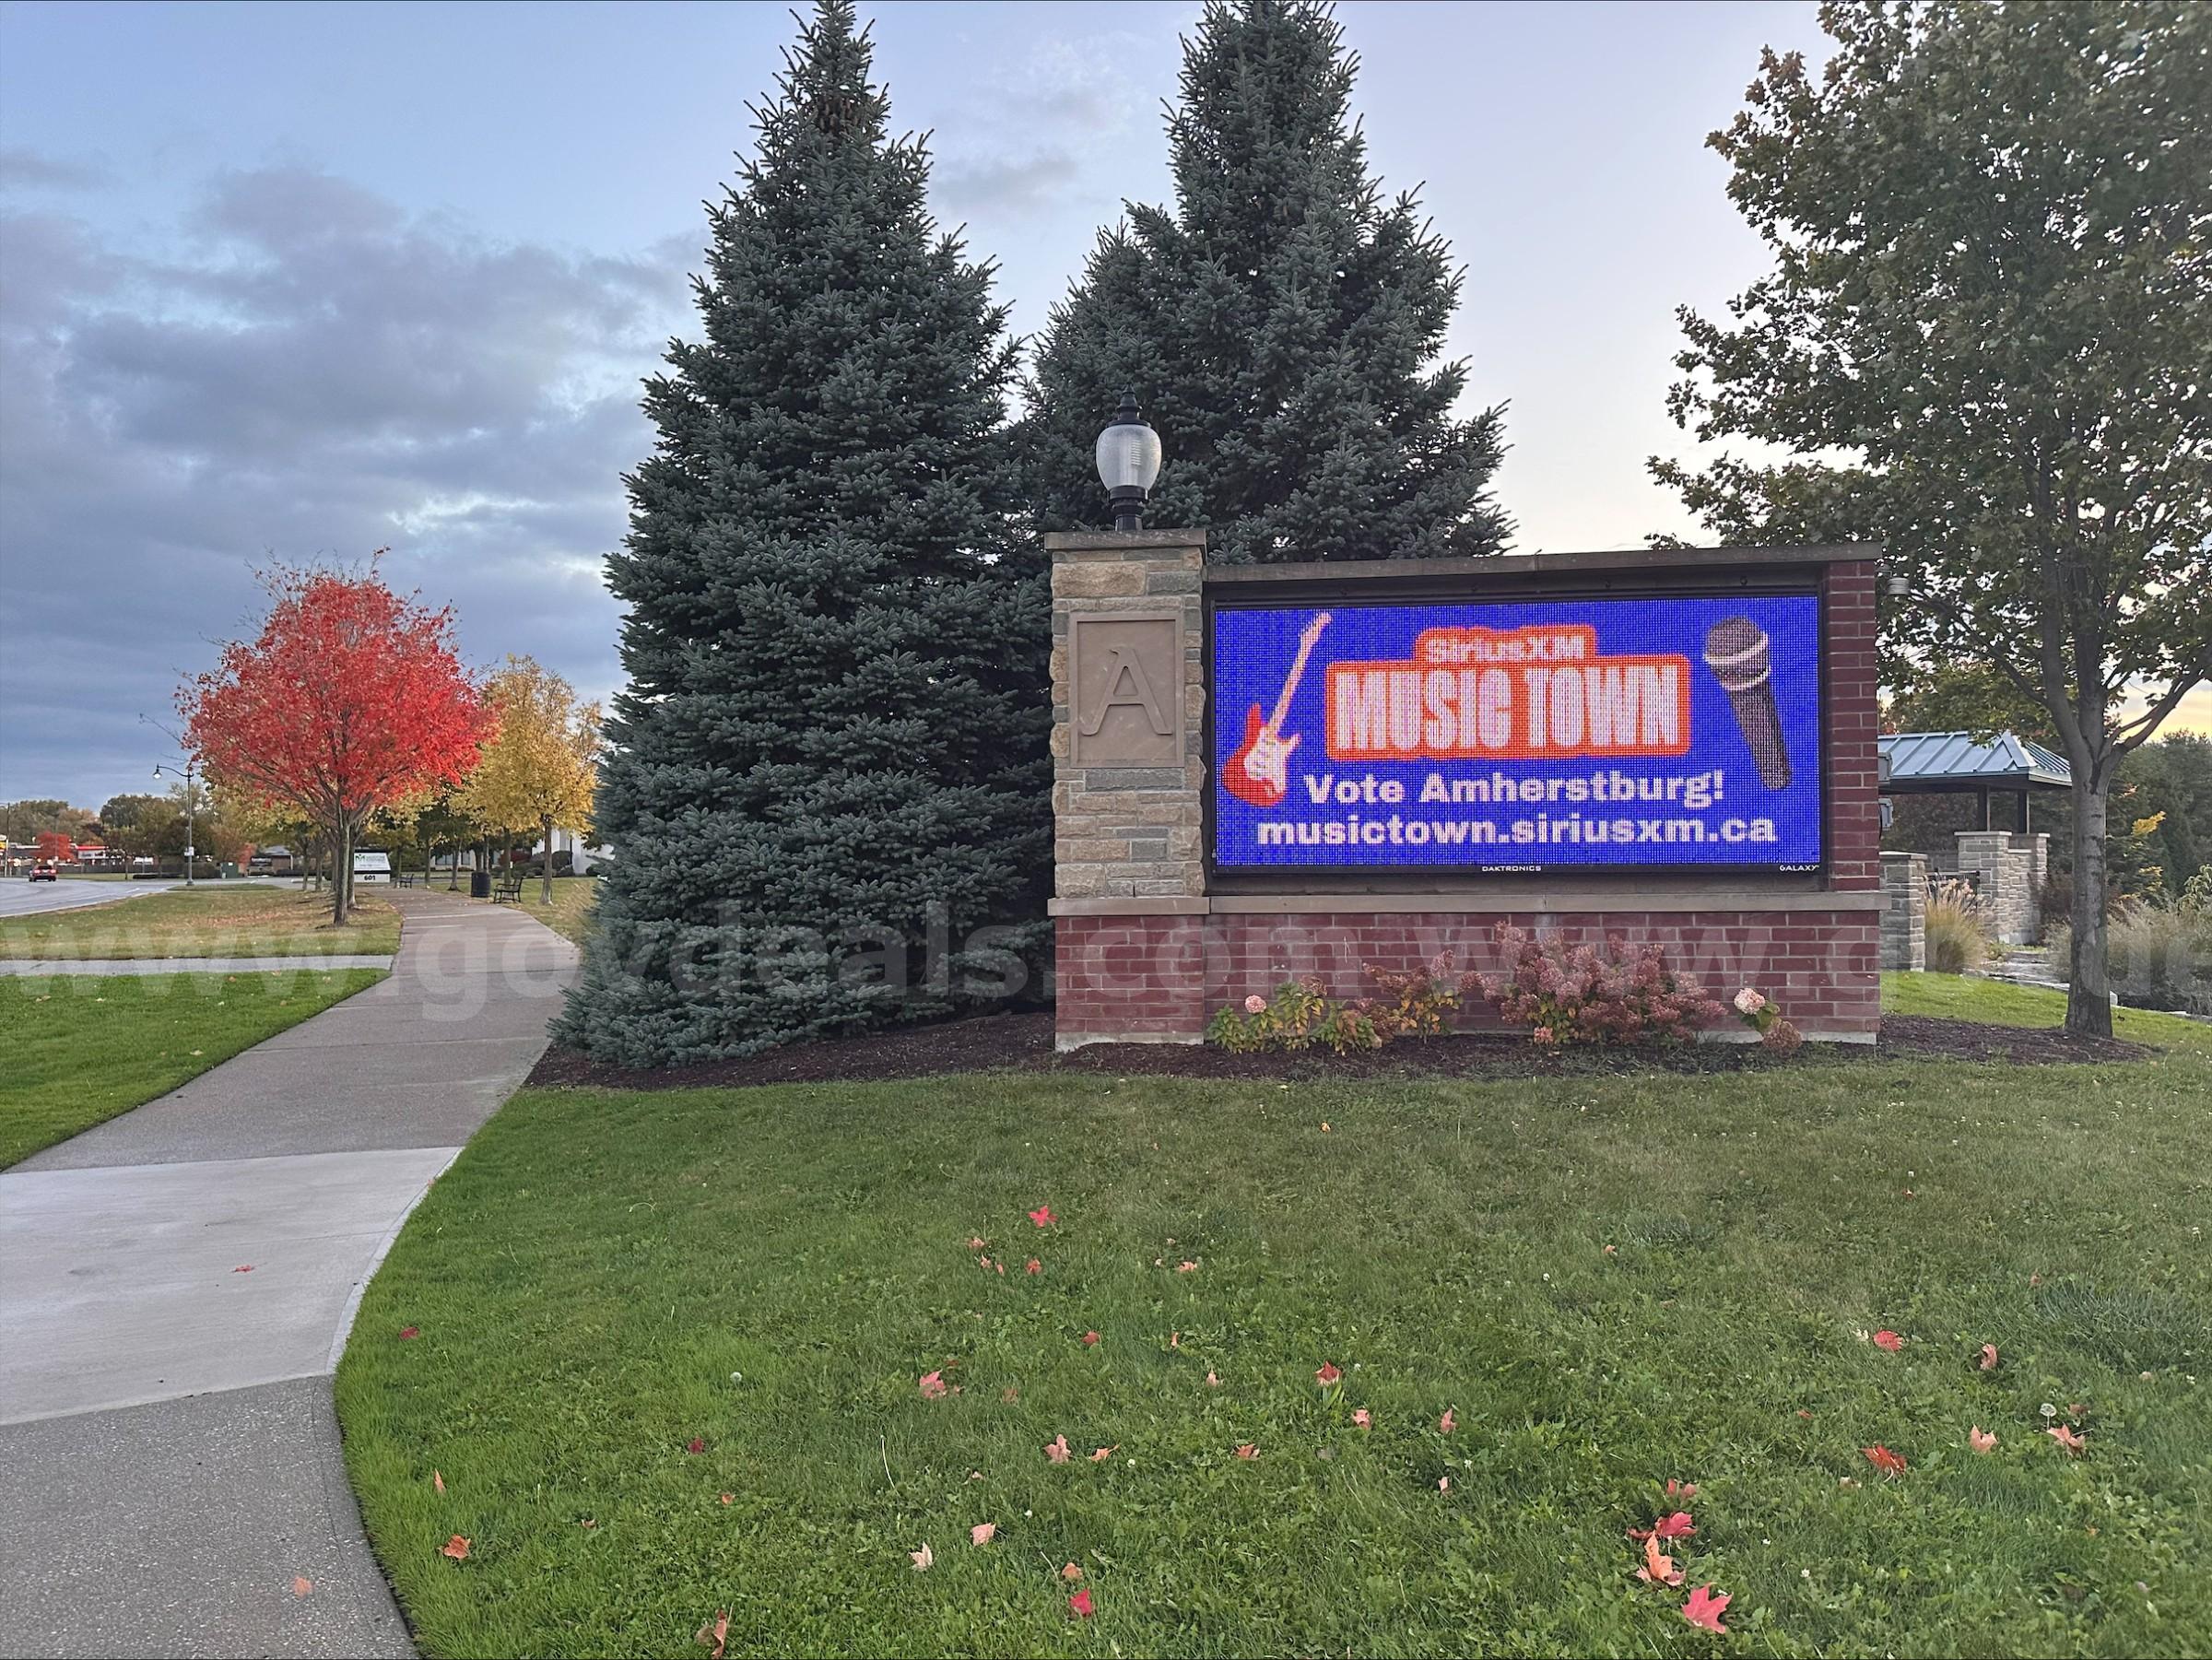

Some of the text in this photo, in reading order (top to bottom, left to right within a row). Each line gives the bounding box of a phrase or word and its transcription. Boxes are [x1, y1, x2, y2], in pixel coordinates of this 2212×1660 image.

[1425, 635, 1586, 664] SiriusXM
[1078, 647, 1173, 736] A
[1335, 665, 1679, 751] MUSIC TOWN
[1303, 770, 1724, 808] Vote Amherstburg!
[1257, 812, 1779, 845] musictown.siriusxm.ca
